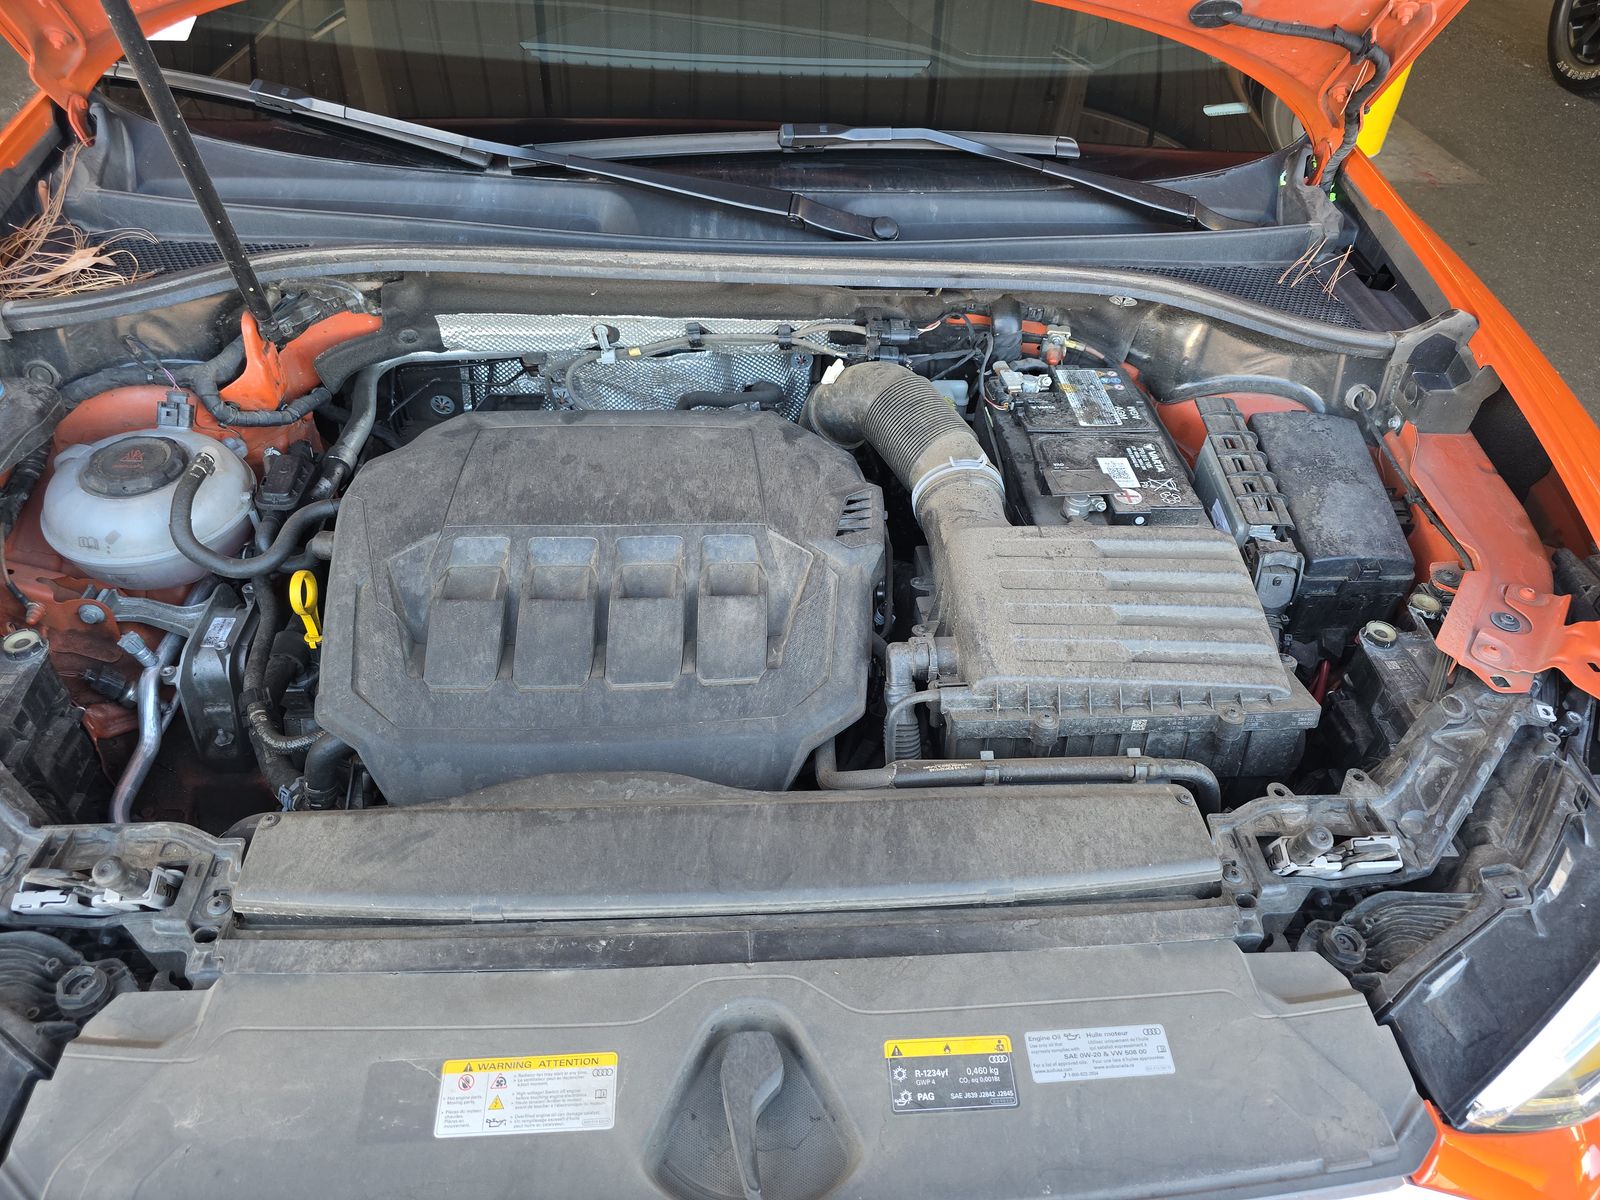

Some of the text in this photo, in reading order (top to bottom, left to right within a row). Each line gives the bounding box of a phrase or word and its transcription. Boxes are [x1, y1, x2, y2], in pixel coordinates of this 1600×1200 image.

[1148, 450, 1166, 472] VARTA
[478, 1057, 599, 1071] WARNING ATTENTION
[915, 1068, 949, 1078] R-1234yf
[966, 1066, 999, 1076] 0,460 kg
[917, 1092, 935, 1101] PAG
[950, 1092, 962, 1100] SAE
